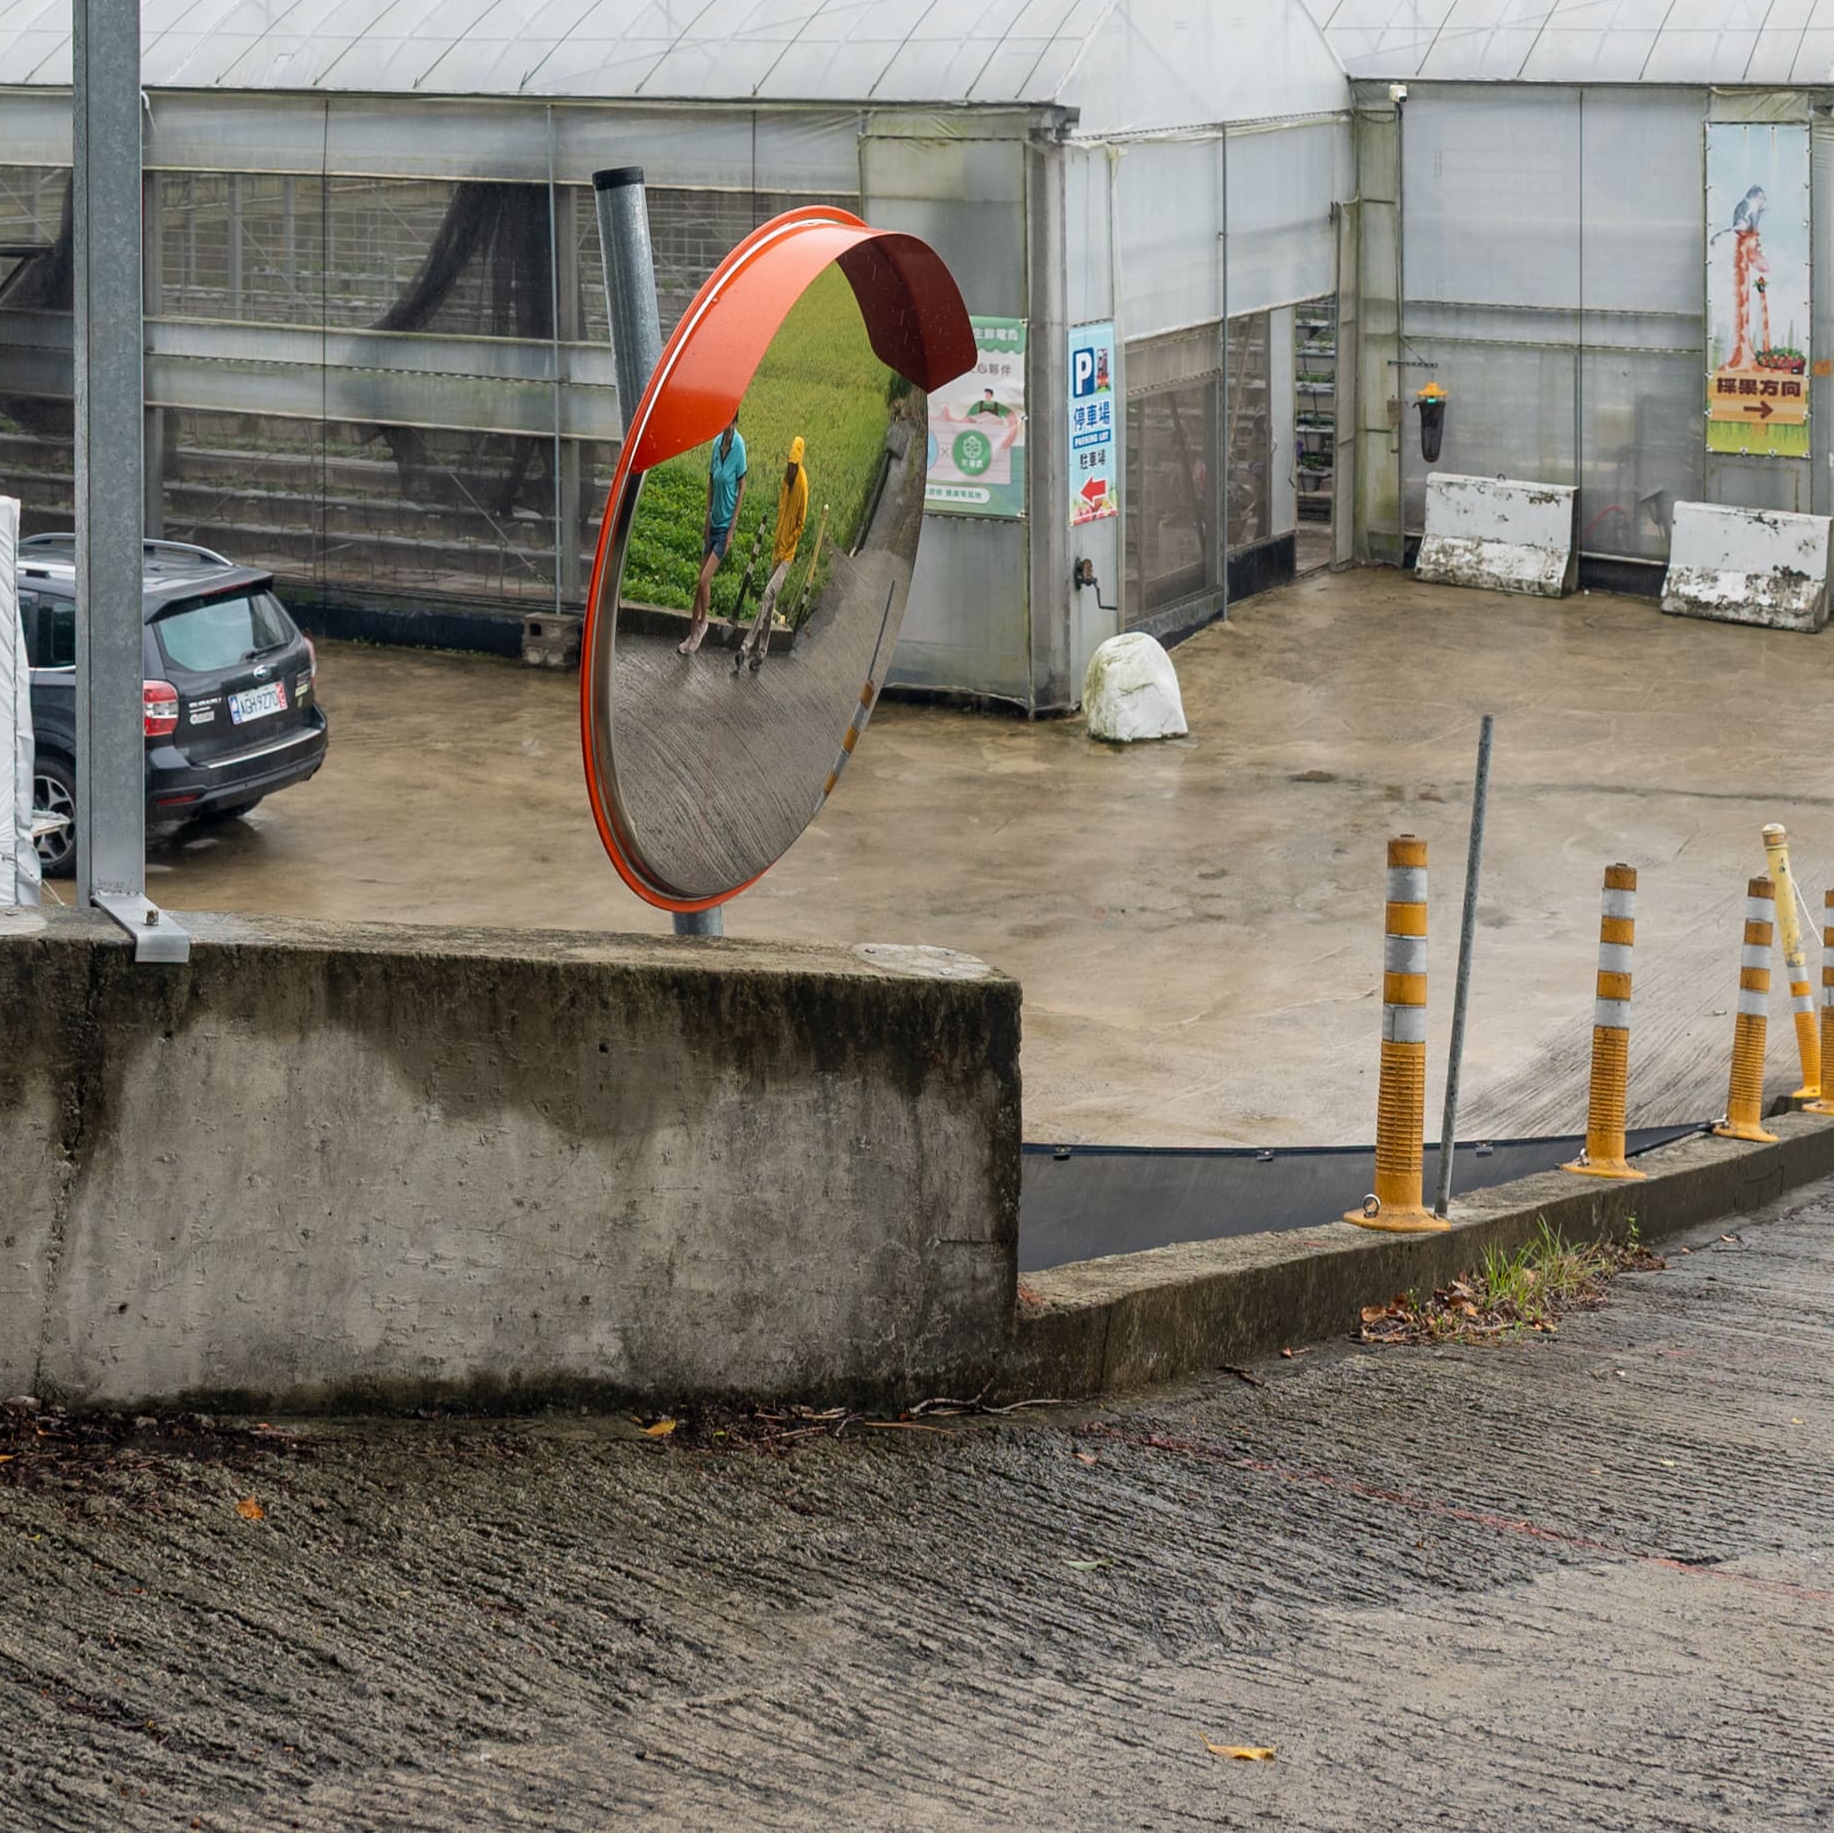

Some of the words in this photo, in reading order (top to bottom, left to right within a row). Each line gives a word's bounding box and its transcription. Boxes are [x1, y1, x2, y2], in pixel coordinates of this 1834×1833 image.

[971, 362, 1013, 378] 心夥伴
[1076, 351, 1093, 396] P
[1717, 377, 1801, 397] 採果方向
[1073, 400, 1111, 432] 停車場
